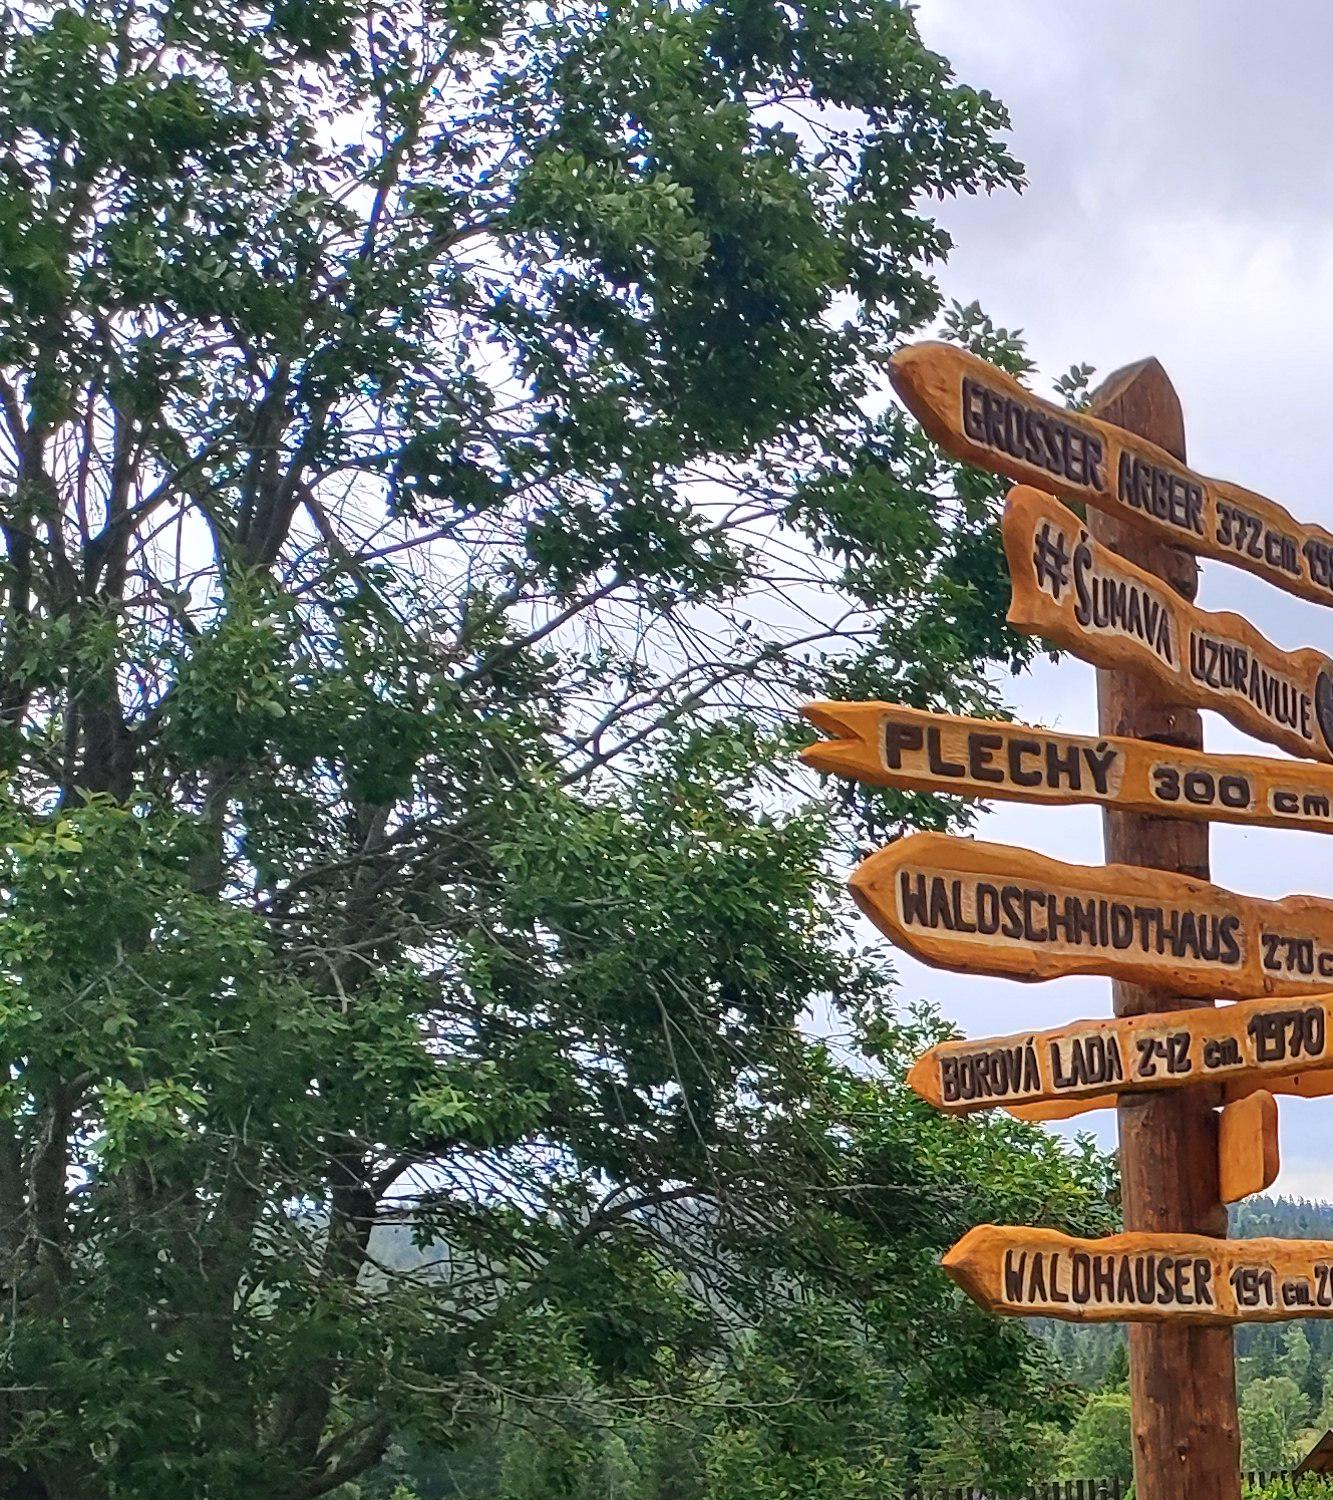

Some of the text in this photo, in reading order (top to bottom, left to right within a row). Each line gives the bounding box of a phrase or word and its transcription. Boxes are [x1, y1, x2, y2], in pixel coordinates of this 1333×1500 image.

[963, 376, 1104, 492] GROSSER
[1118, 449, 1204, 536] ARBER
[1216, 502, 1264, 559] 372
[1190, 631, 1313, 740] UZDRAVUJE
[885, 721, 1118, 795] PLECHÝ
[1152, 766, 1250, 809] 300
[900, 871, 1241, 965] WALDSCHMIDTHAUS
[1261, 934, 1315, 975] 270
[940, 1035, 1042, 1102] BOROVÁ
[1050, 1034, 1123, 1089] LADA
[1136, 1031, 1193, 1078] 242
[1247, 1007, 1325, 1063] 1970
[1004, 1248, 1214, 1306] WALDHAUSER
[1229, 1266, 1275, 1307] 191
